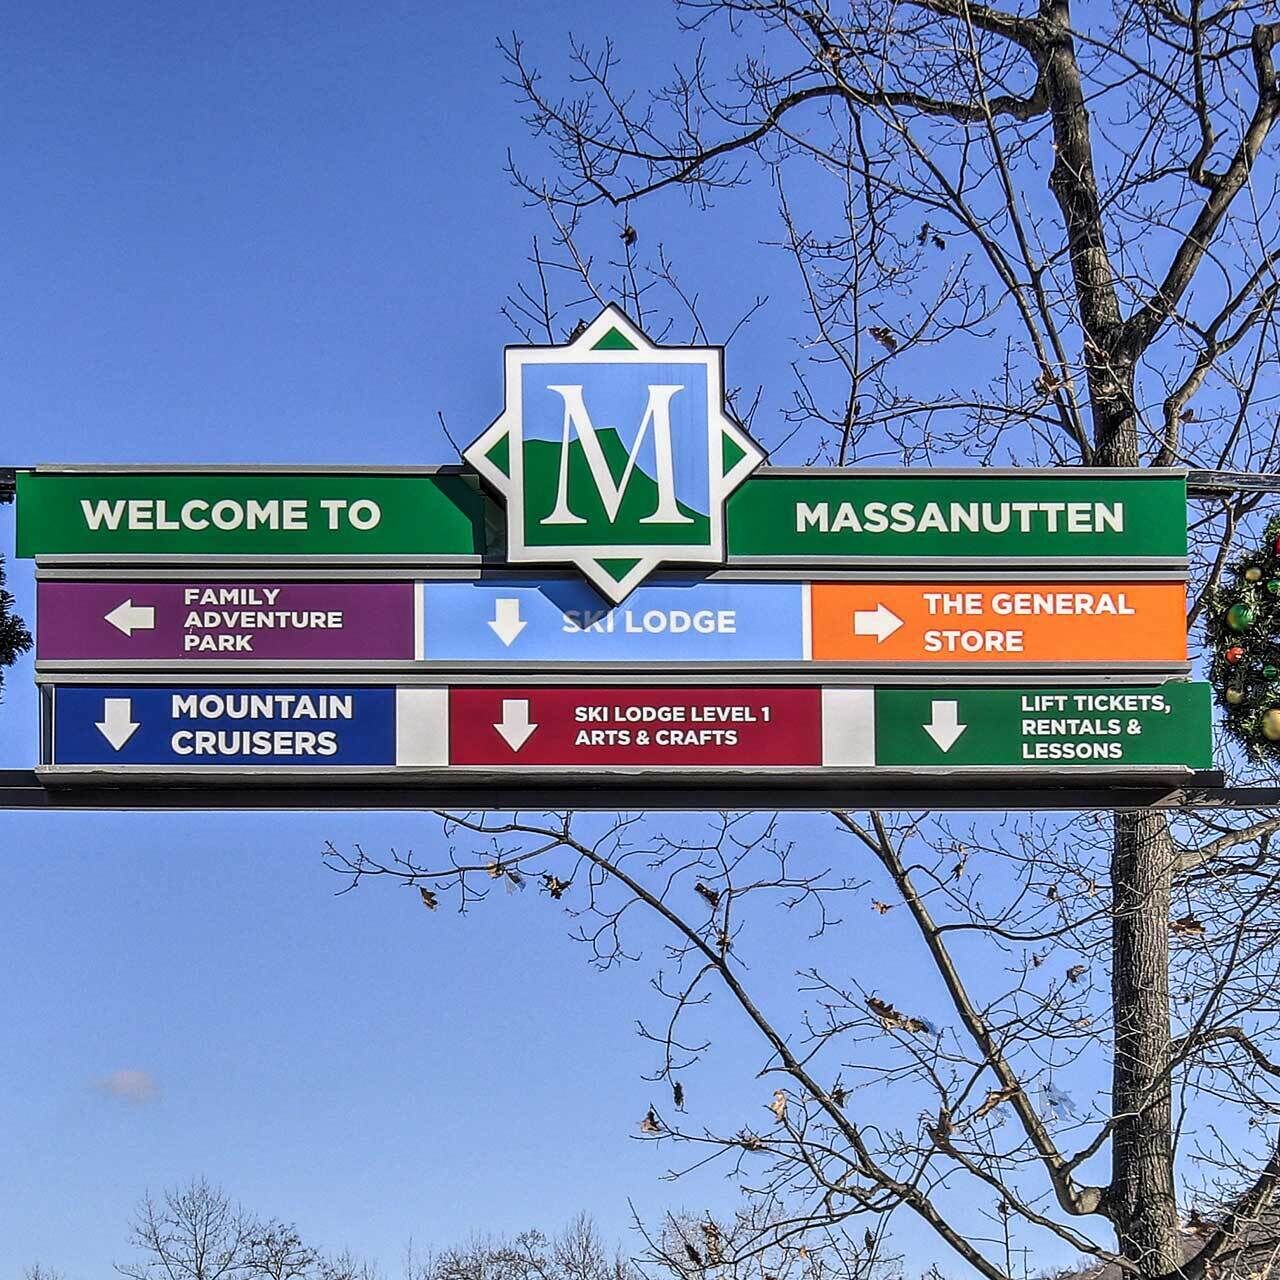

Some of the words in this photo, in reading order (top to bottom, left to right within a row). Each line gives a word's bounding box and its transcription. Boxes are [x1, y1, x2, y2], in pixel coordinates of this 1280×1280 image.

[540, 384, 695, 525] M
[79, 499, 309, 531] WELCOME
[320, 499, 382, 531] TO
[795, 501, 1125, 534] MASSANUTTEN
[183, 588, 282, 606] FAMILY
[922, 592, 984, 616] THE
[990, 592, 1136, 616] GENERAL
[183, 611, 344, 630] ADVENTURE
[562, 609, 615, 634] SKI
[625, 609, 737, 634] LODGE
[183, 634, 254, 653] PARK
[923, 629, 1025, 653] STORE
[171, 693, 353, 720] MOUNTAIN
[574, 705, 609, 723] SKI
[613, 705, 687, 723] LODGE
[691, 705, 756, 723] LEVEL
[760, 705, 771, 723] 1
[1021, 694, 1067, 713] LIFT
[1072, 694, 1172, 715] TICKETS,
[1021, 717, 1123, 736] RENTALS
[1125, 717, 1143, 736] &
[171, 729, 338, 757] CRUISERS
[574, 729, 631, 747] ARTS
[634, 729, 651, 747] &
[654, 729, 739, 747] CRAFTS
[1021, 741, 1124, 760] LESSONS
